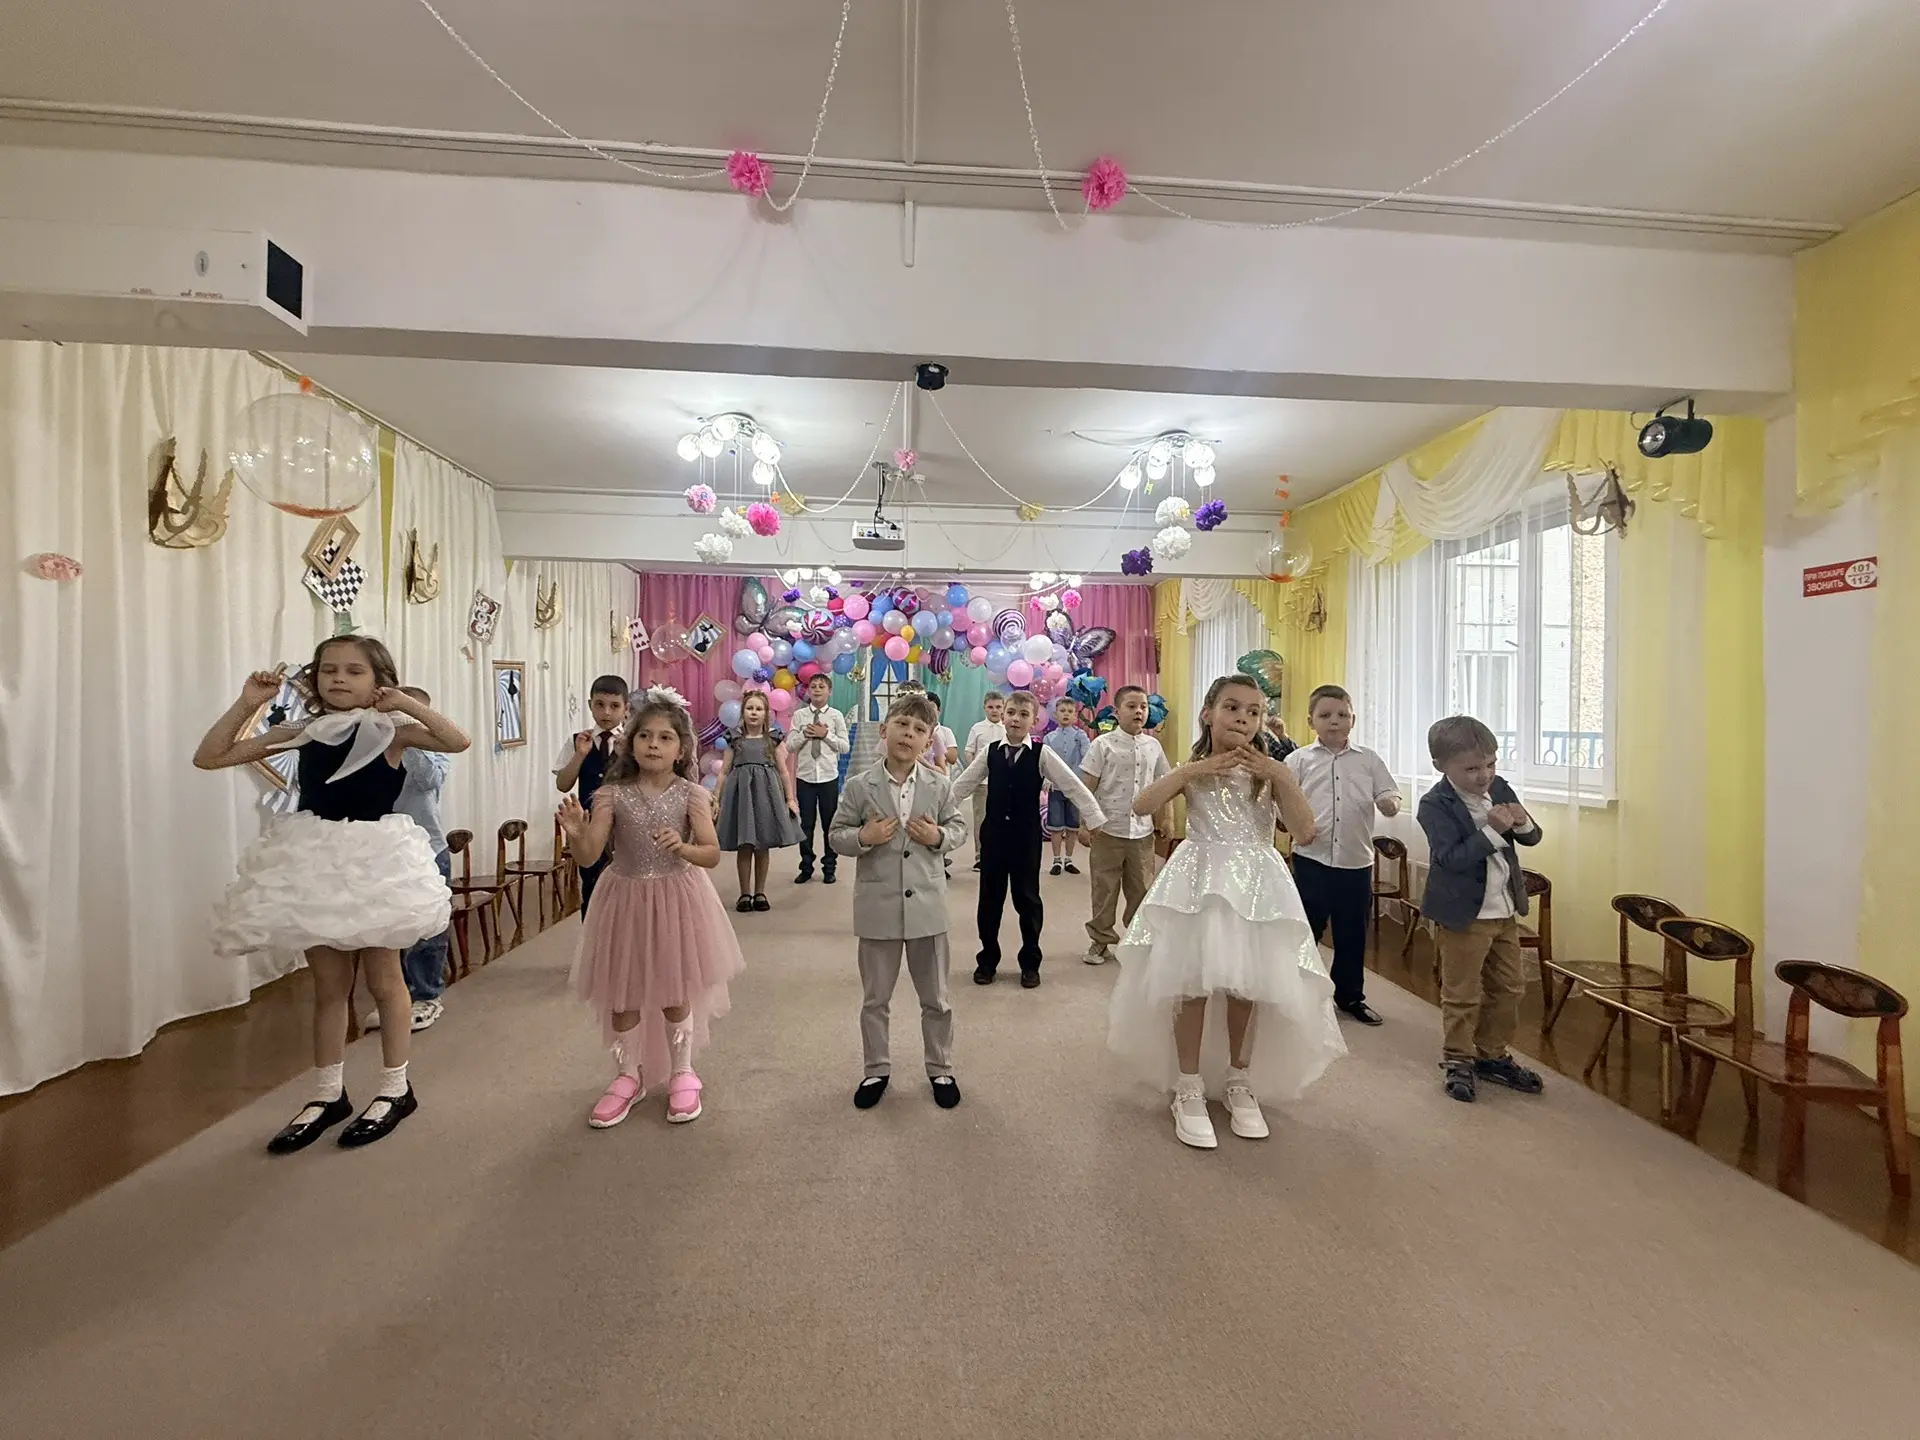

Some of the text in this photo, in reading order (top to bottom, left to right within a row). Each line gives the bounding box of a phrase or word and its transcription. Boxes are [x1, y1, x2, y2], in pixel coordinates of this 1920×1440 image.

[1852, 563, 1870, 572] 101
[1851, 575, 1870, 584] 112
[1806, 580, 1844, 592] ЗВОНИТЬ
